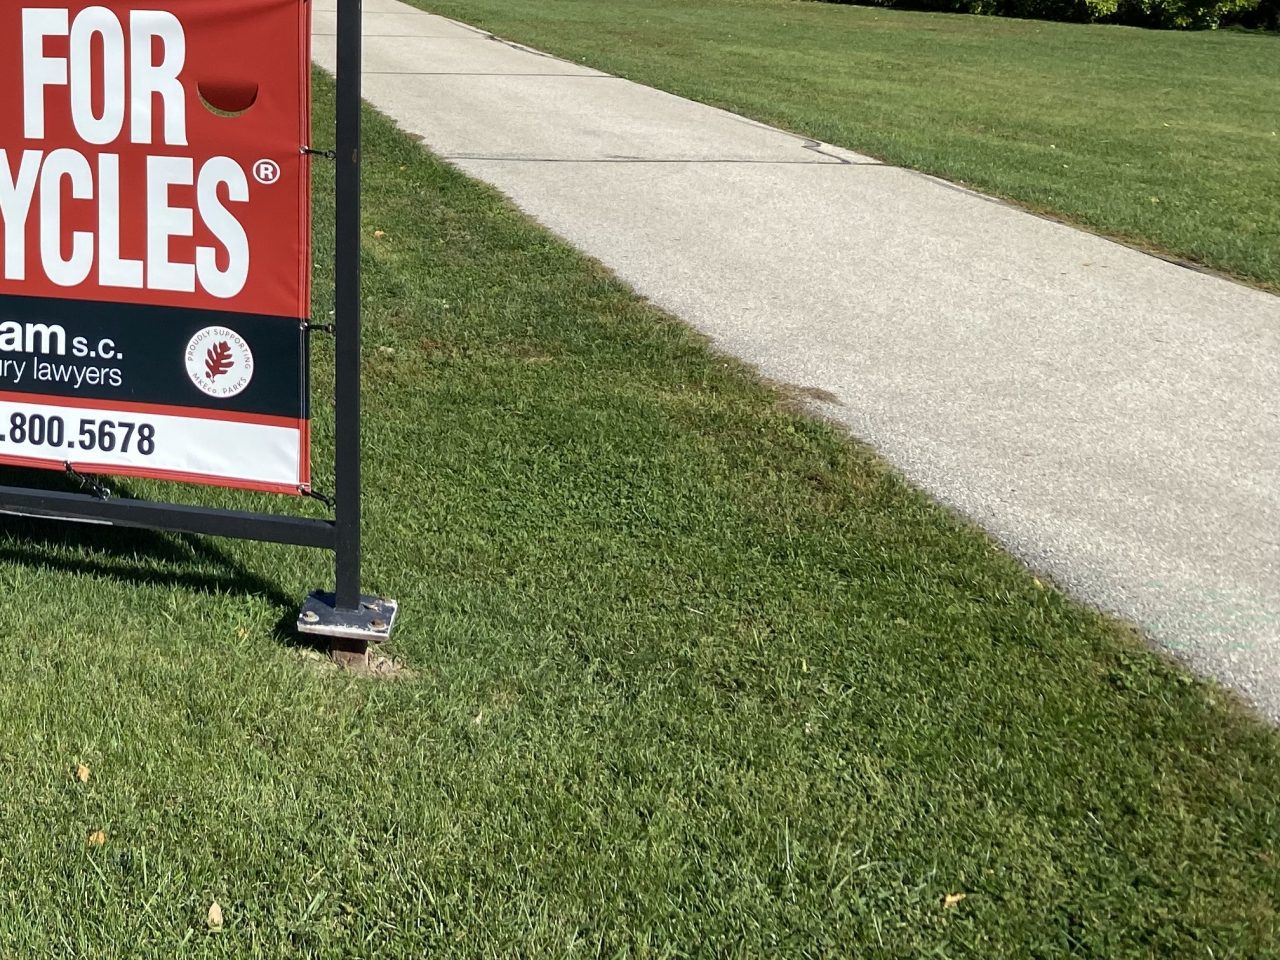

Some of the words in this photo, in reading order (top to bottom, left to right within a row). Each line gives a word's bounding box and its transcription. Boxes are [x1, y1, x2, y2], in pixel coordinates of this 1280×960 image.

[22, 5, 189, 146] FOR
[72, 336, 123, 360] s.c.
[187, 329, 211, 362] PROUDLY
[213, 328, 252, 369] SUPPORTING
[33, 356, 123, 389] lawyers
[222, 376, 248, 395] PARKS
